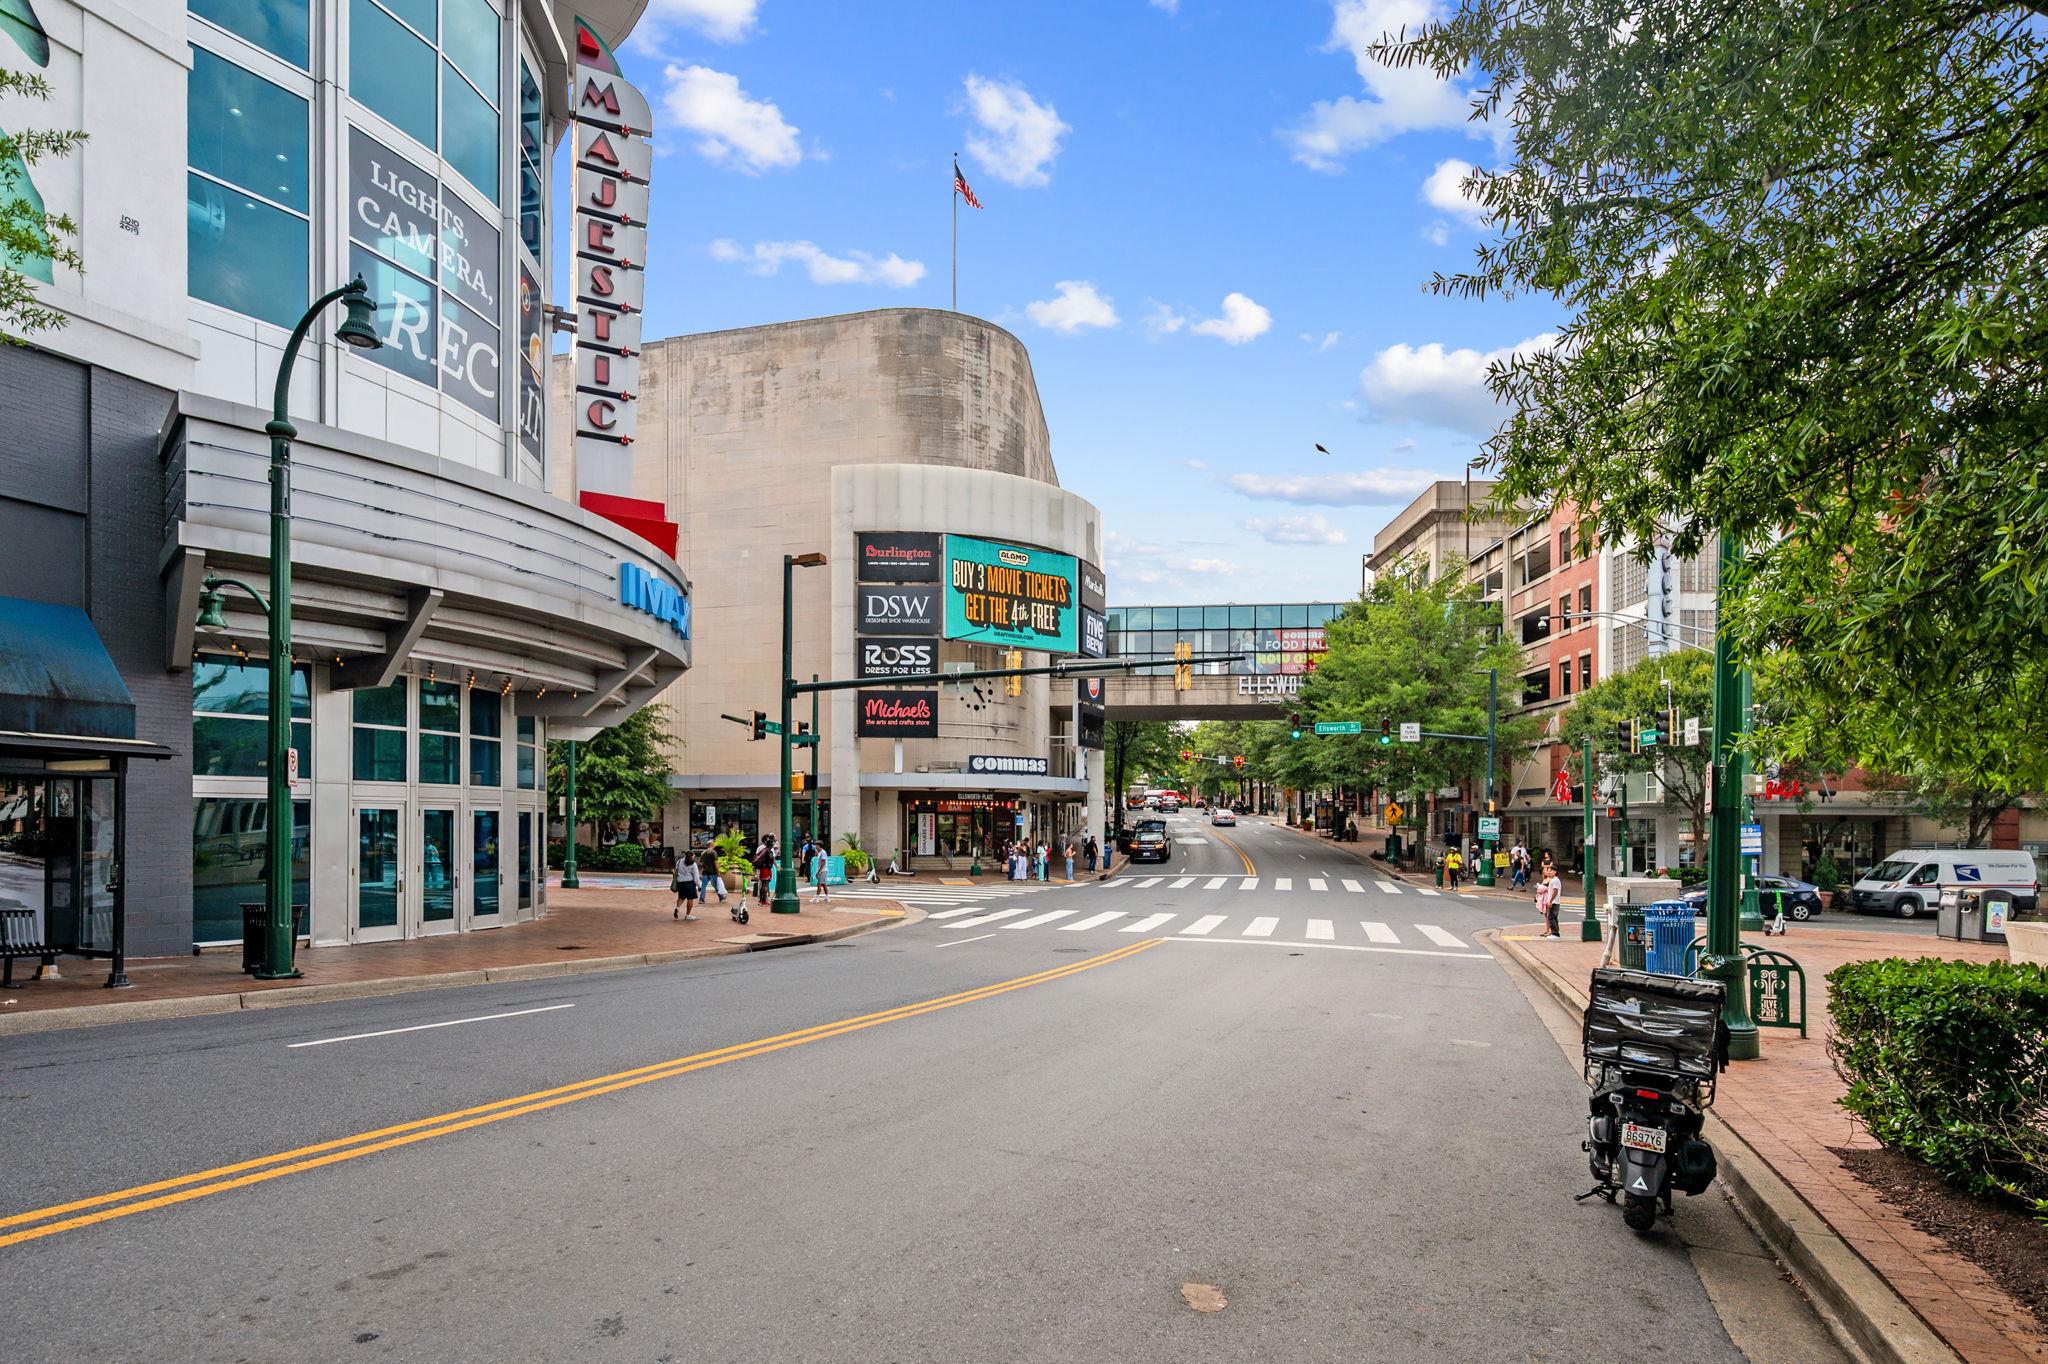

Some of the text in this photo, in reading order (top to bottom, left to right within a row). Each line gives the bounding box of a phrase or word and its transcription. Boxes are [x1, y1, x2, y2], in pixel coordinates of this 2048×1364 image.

[370, 160, 469, 247] LIGHTS,
[357, 196, 494, 306] CAMERA,
[580, 76, 621, 431] MAJESTIC
[382, 289, 499, 399] REC
[865, 544, 933, 561] Burlington
[1000, 551, 1028, 562] ALAMO
[952, 560, 1067, 603] BUY 3 MOVIE TICKETS
[621, 562, 692, 641] IMAX
[865, 595, 931, 618] DSW
[965, 592, 1056, 631] GET THE 4th FREE
[865, 644, 932, 665] ROSS
[1265, 640, 1299, 650] FOOD
[1257, 652, 1328, 665] NOW OPE
[865, 666, 890, 674] DRESS
[865, 698, 931, 718] Michaels
[972, 757, 1047, 773] commas
